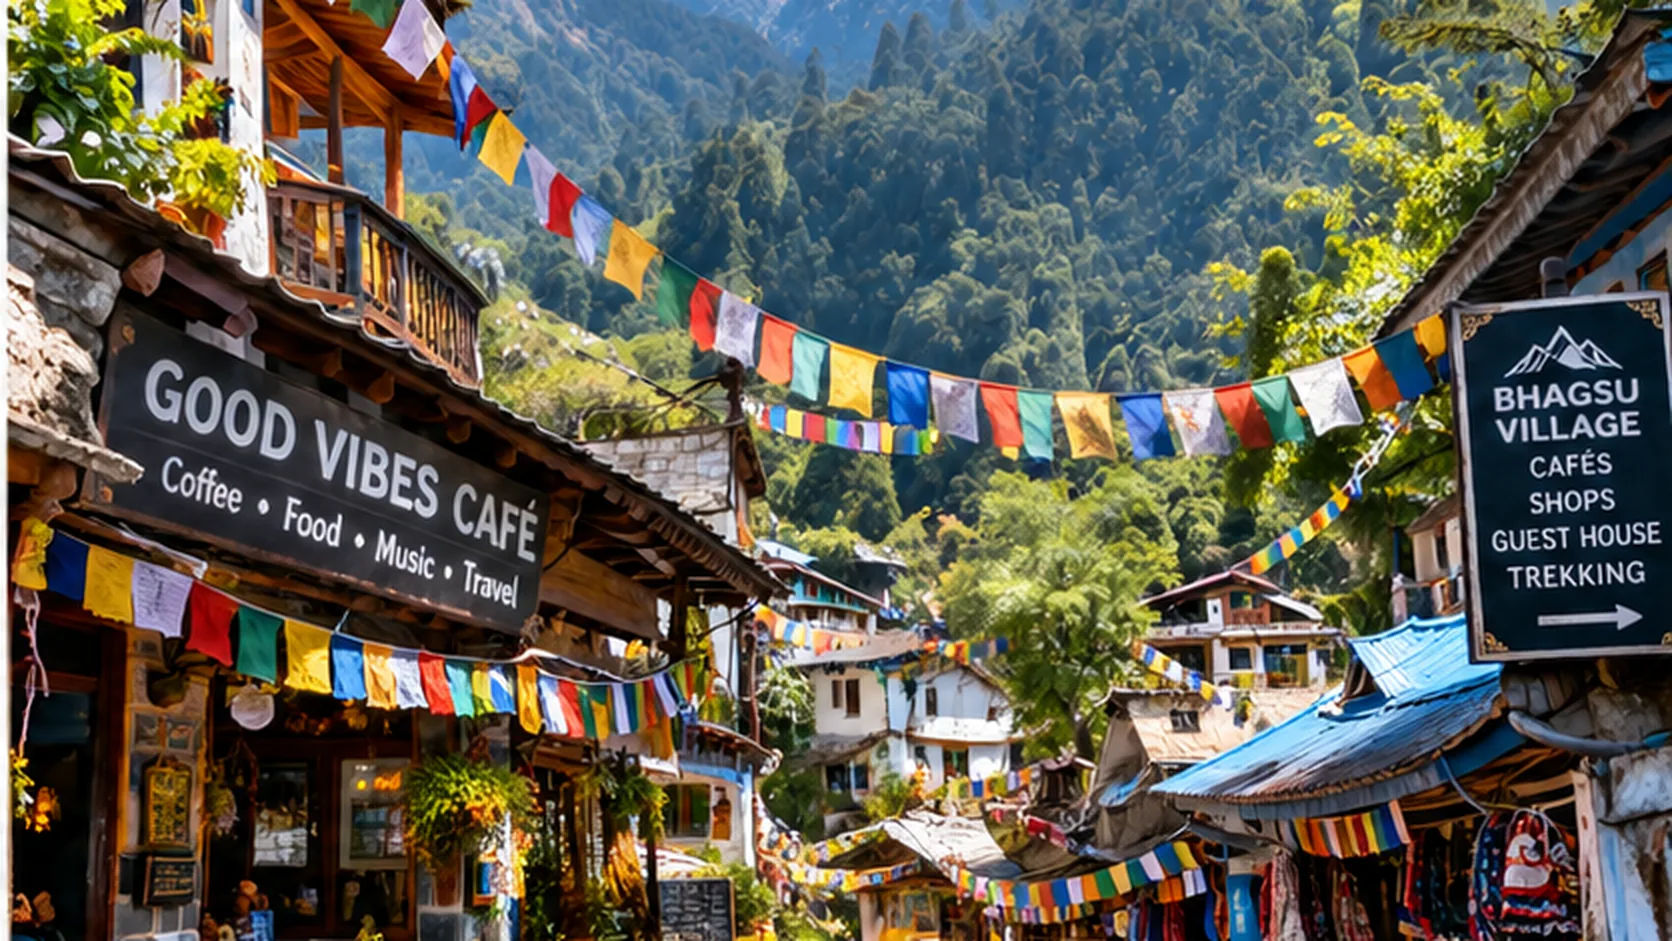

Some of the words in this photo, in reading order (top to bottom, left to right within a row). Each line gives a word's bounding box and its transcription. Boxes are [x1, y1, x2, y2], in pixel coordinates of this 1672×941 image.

[1494, 378, 1639, 412] BHAGSU
[1495, 411, 1641, 443] VILLAGE
[144, 359, 296, 461] GOOD
[315, 419, 439, 519] VIBES
[453, 483, 538, 563] CAFÉ
[1529, 449, 1613, 478] CAFÉS
[1529, 488, 1616, 514] SHOPS
[161, 455, 243, 514] Coffee
[283, 496, 342, 548] Food
[374, 530, 436, 580] Music
[463, 559, 518, 609] Travel
[1491, 527, 1570, 552] GUEST
[1580, 522, 1662, 548] HOUSE
[1507, 561, 1645, 589] TREKKING
